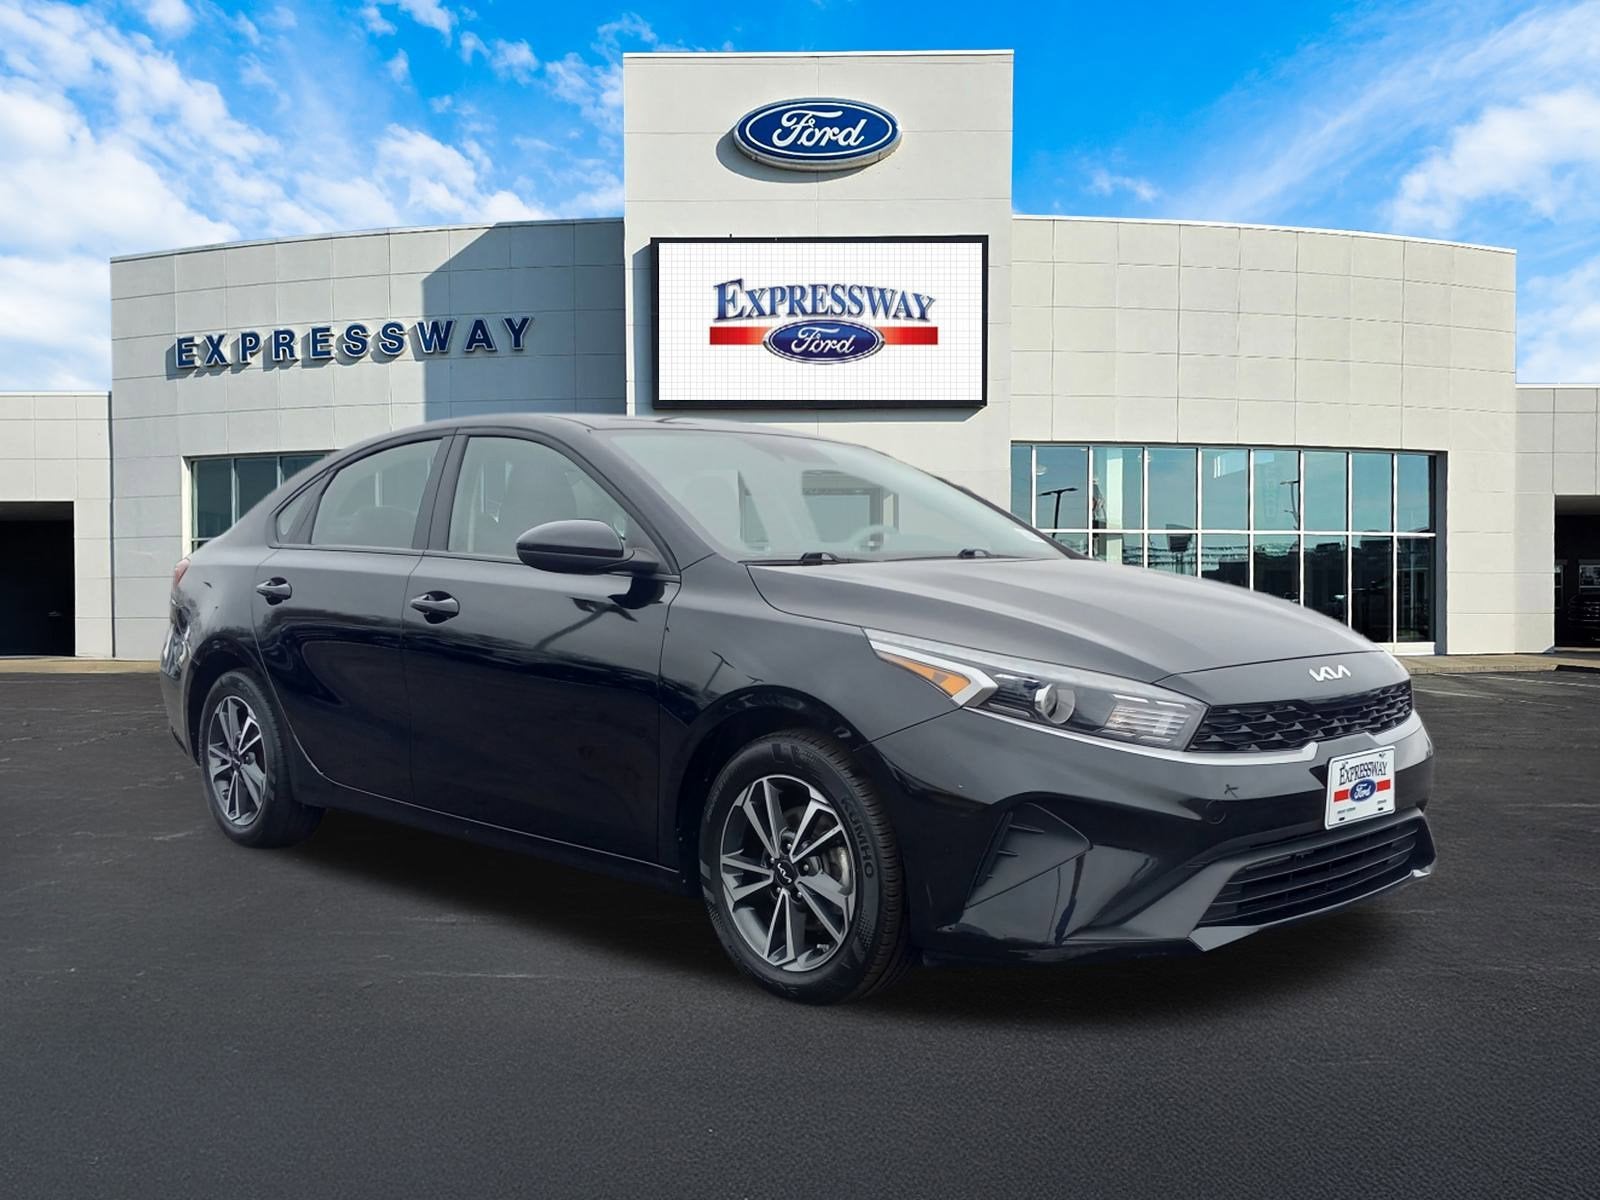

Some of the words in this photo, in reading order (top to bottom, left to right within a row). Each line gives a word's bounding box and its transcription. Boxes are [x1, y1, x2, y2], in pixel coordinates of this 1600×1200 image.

[772, 110, 867, 147] Ford
[713, 278, 935, 322] EXPRESSWAY
[175, 316, 532, 368] EXPRESSWAY
[791, 326, 856, 353] Ford
[1309, 665, 1351, 681] KIA
[1354, 783, 1371, 799] Ford
